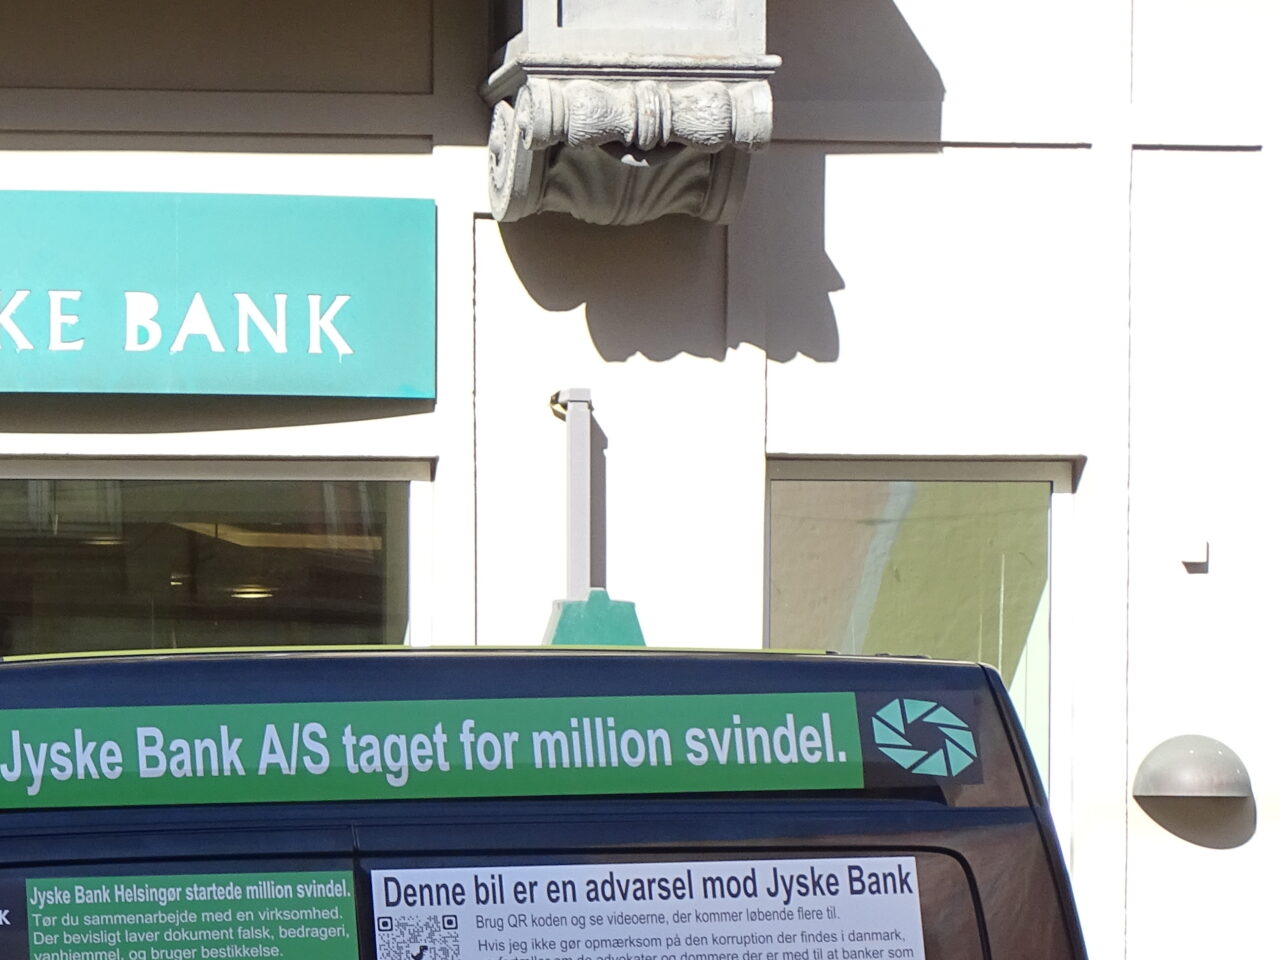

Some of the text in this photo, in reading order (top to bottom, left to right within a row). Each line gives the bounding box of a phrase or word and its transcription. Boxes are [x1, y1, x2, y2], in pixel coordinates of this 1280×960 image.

[123, 291, 354, 357] BANK
[135, 723, 246, 778] Bank
[257, 721, 330, 775] A/S
[340, 721, 450, 787] taget
[458, 718, 520, 771] for
[531, 715, 673, 769] million
[684, 711, 847, 766] svindel.
[29, 878, 351, 910] Jyske Bank Helsingør startede million svindel.
[382, 862, 913, 908] Denne bil er en advarsel mod Jyske Bank
[30, 905, 343, 927] Tør du sammenarbejde med en virksomhed.
[474, 905, 841, 931] Brug QR koden og se videoerne, der kommer løbende flere til.
[32, 924, 350, 946] Der bevisligt laver dokument falsk, bedrageri,
[200, 943, 283, 959] bestikkelse.
